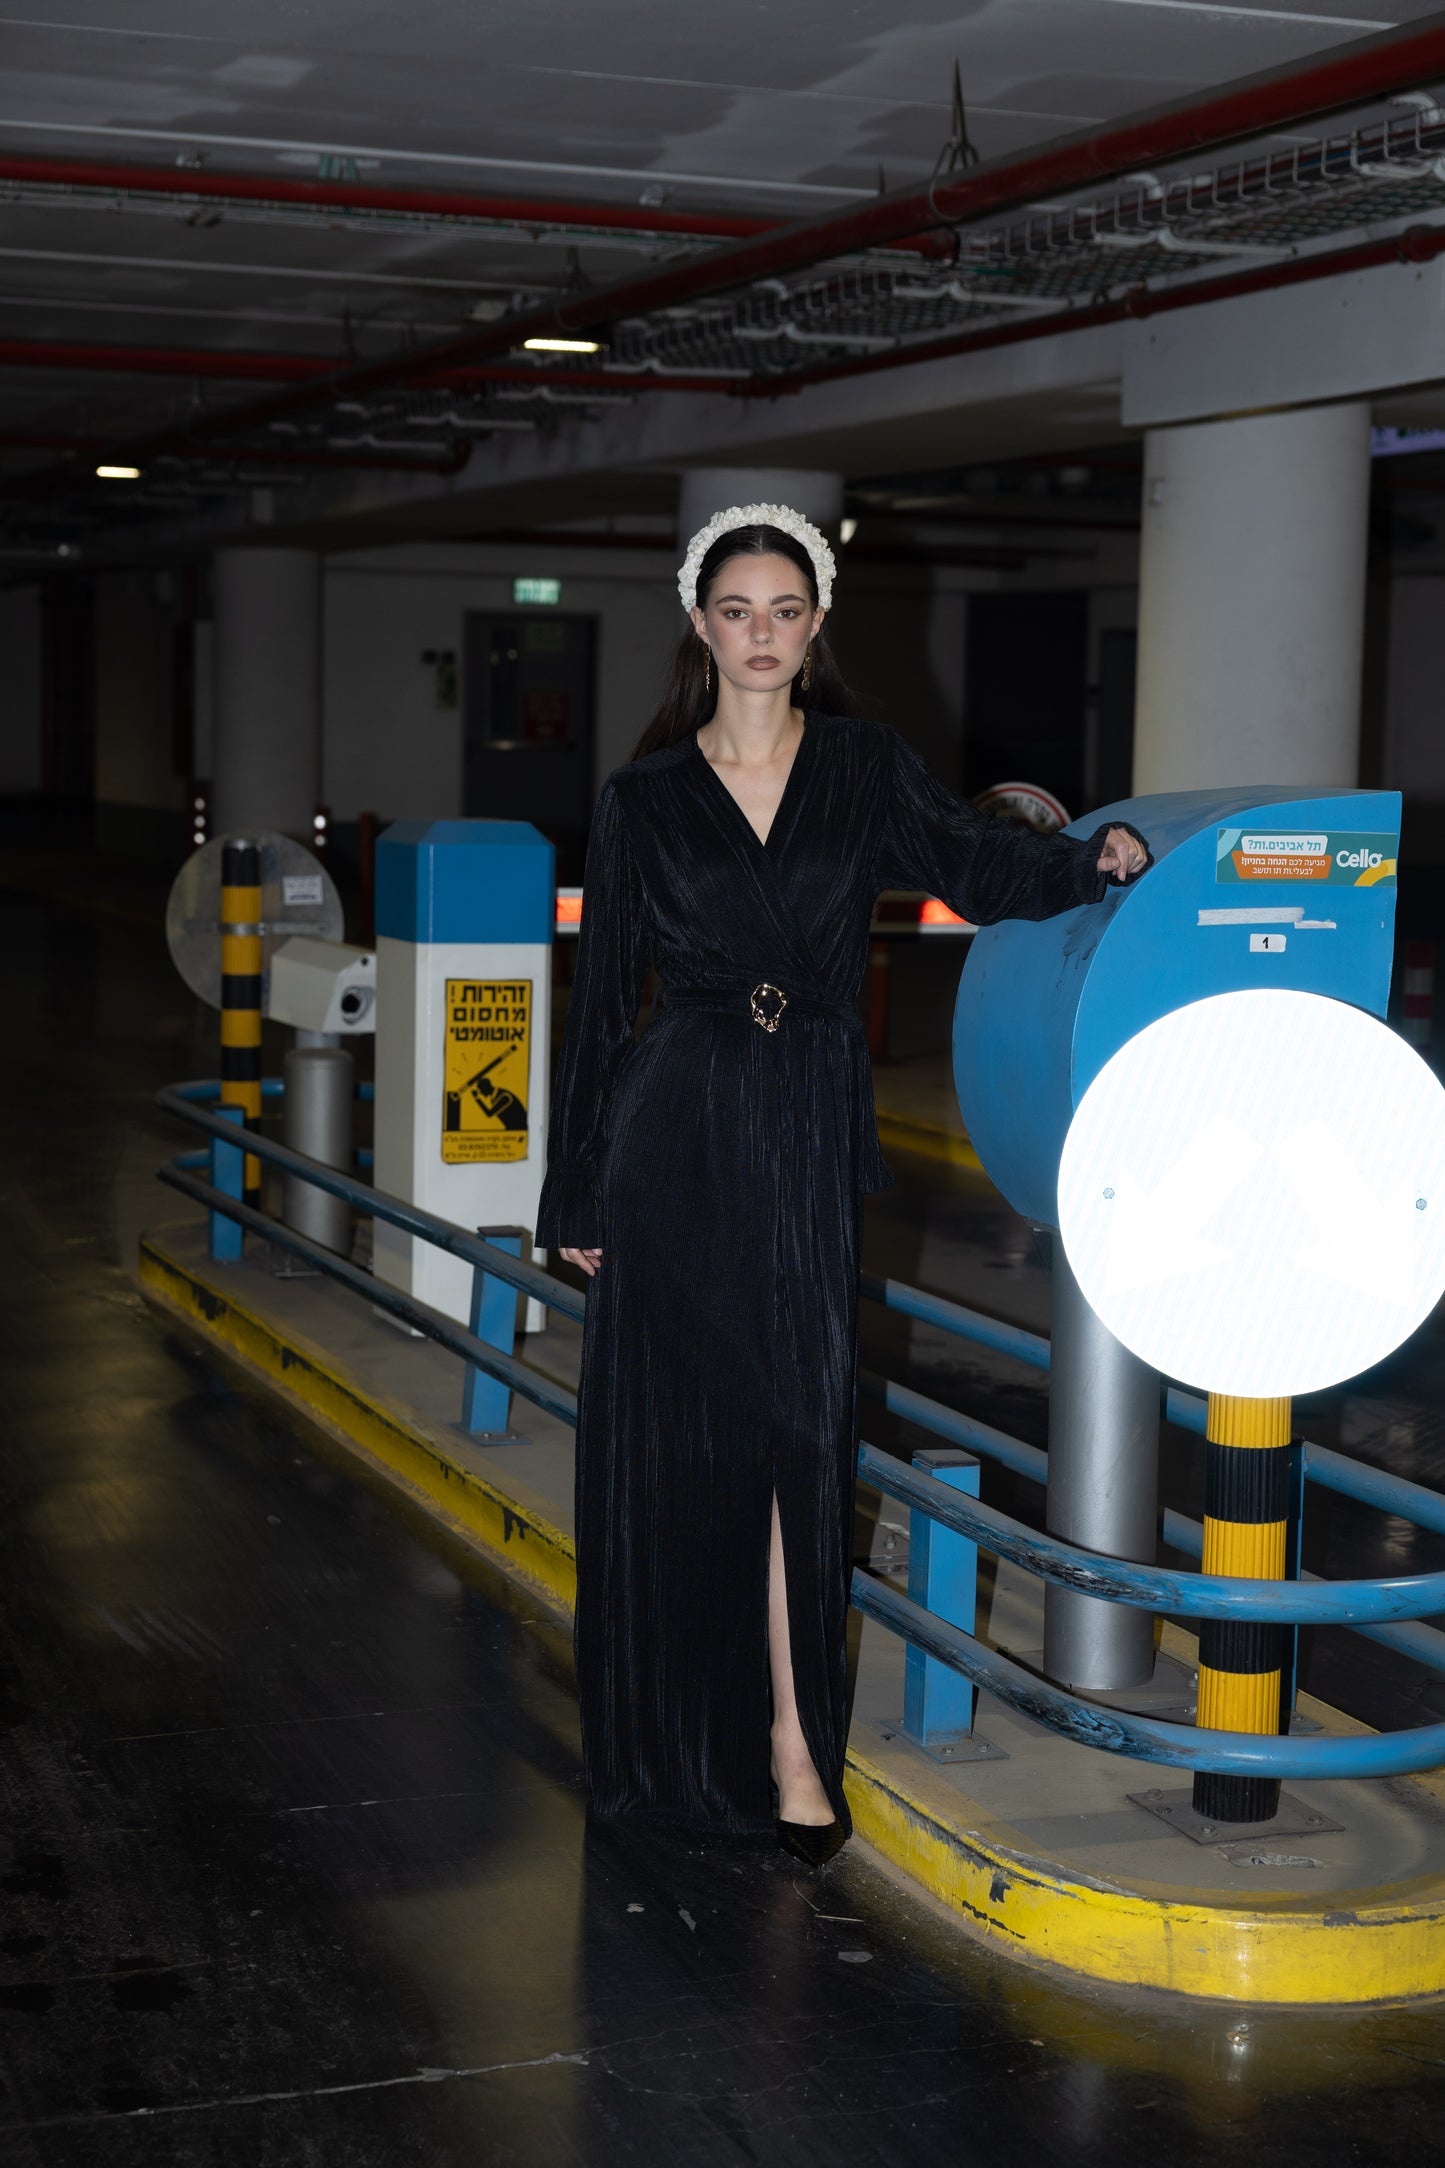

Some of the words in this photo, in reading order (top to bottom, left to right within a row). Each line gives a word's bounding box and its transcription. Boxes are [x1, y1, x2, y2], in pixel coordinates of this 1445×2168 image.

[1306, 840, 1321, 851] תל
[1288, 858, 1302, 866] לכם
[1336, 848, 1383, 868] Cello
[1262, 936, 1269, 949] 1
[453, 1007, 526, 1022] מחסום
[450, 1026, 525, 1042] אוטומטי
